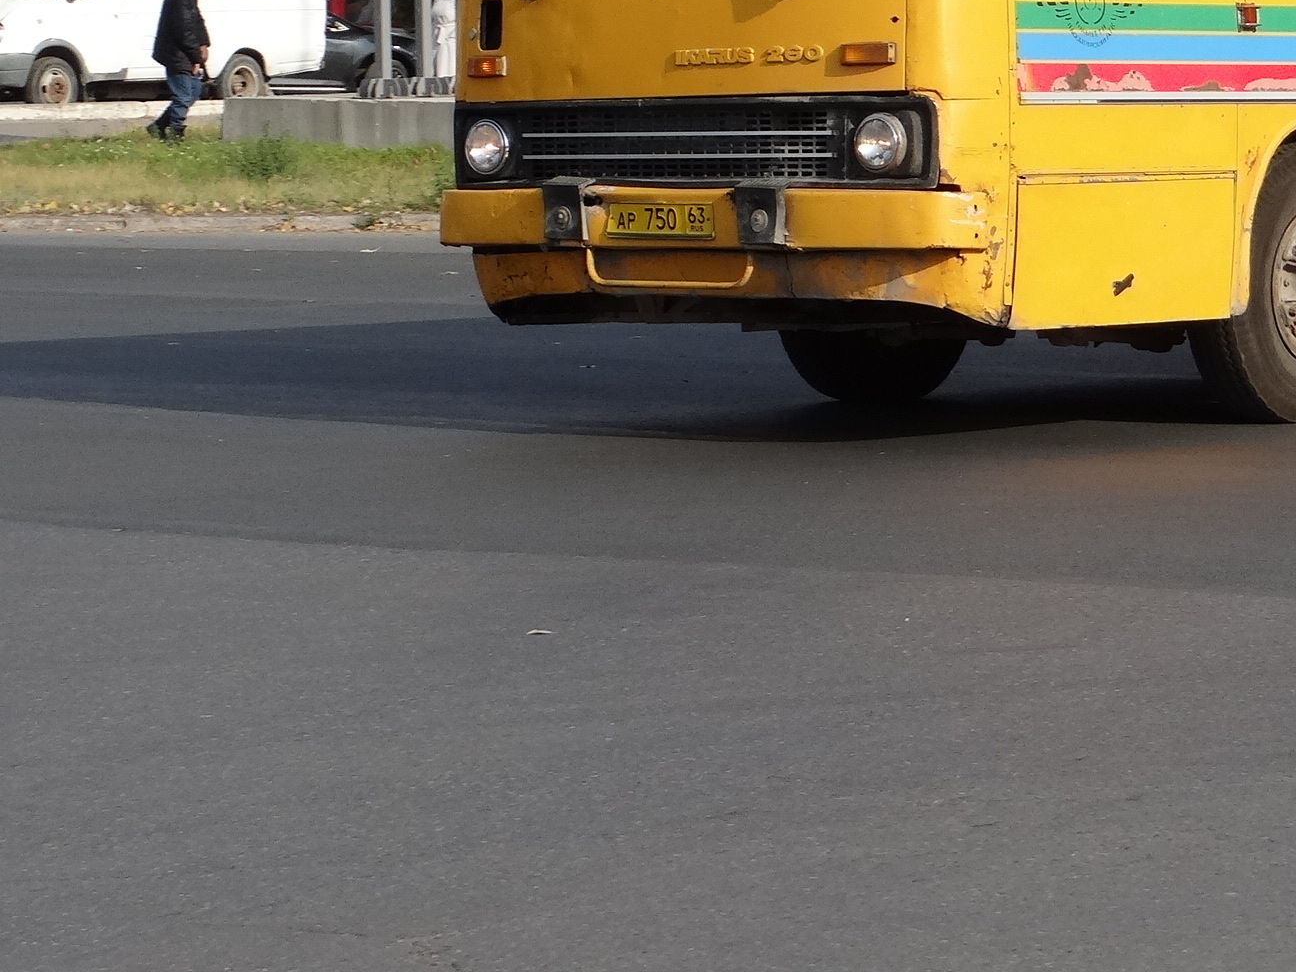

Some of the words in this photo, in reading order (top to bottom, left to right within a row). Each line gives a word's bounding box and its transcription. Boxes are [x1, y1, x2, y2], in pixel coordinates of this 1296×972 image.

[675, 47, 755, 66] IKARUS
[767, 44, 824, 63] 260
[617, 212, 636, 229] АР
[644, 207, 677, 230] 750
[688, 207, 705, 223] 63
